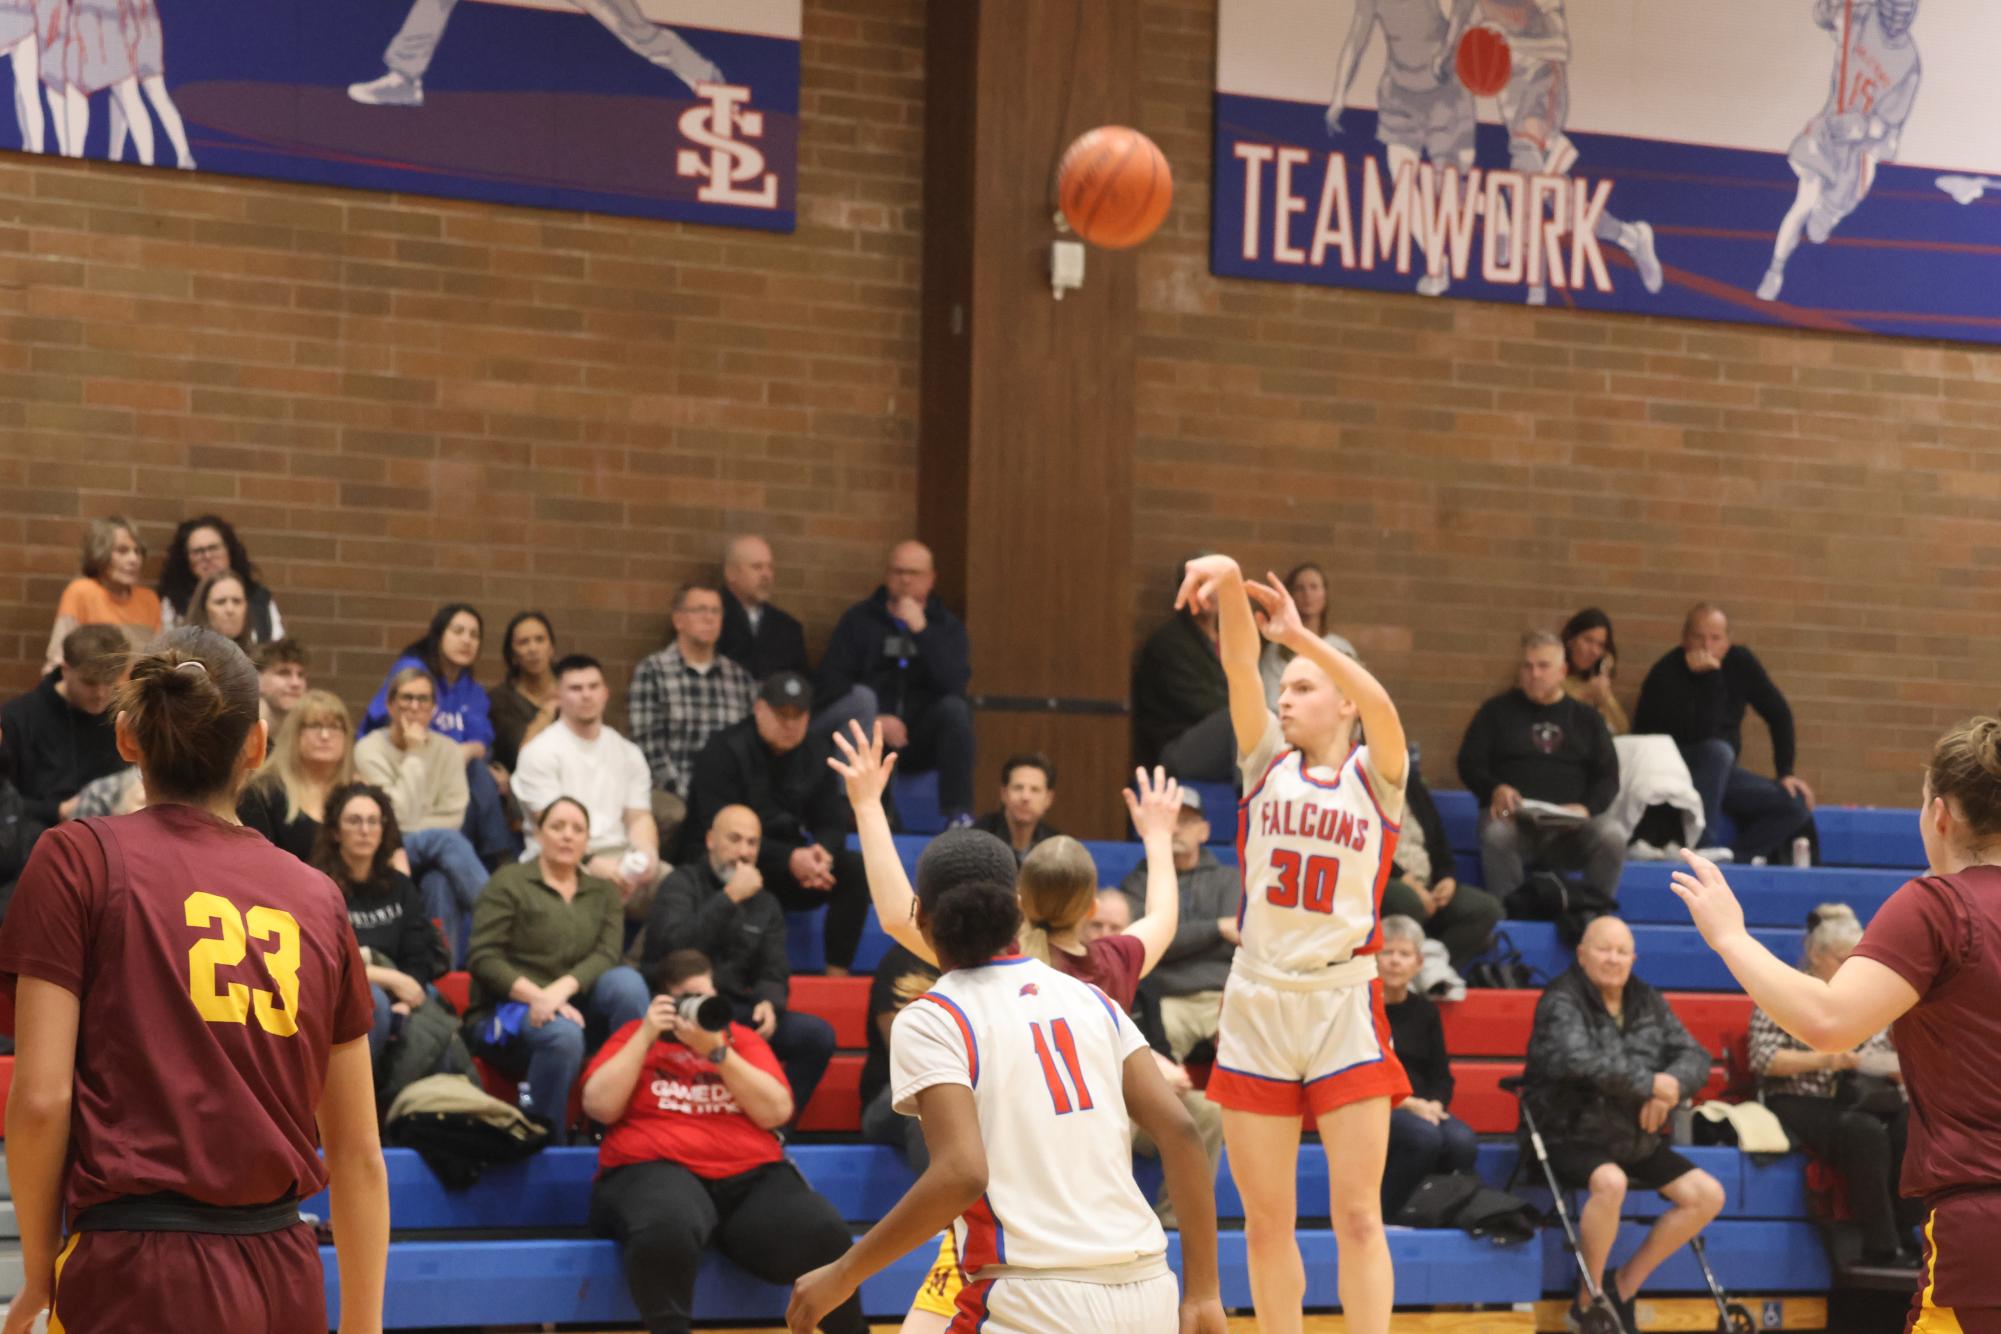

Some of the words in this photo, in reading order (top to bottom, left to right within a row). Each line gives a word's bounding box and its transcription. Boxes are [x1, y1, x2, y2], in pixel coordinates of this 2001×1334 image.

[1233, 141, 1614, 292] TEAMWORK
[1261, 800, 1369, 853] FALCONS
[1266, 847, 1341, 915] 30
[183, 891, 301, 1038] 23
[1028, 1017, 1094, 1116] 11
